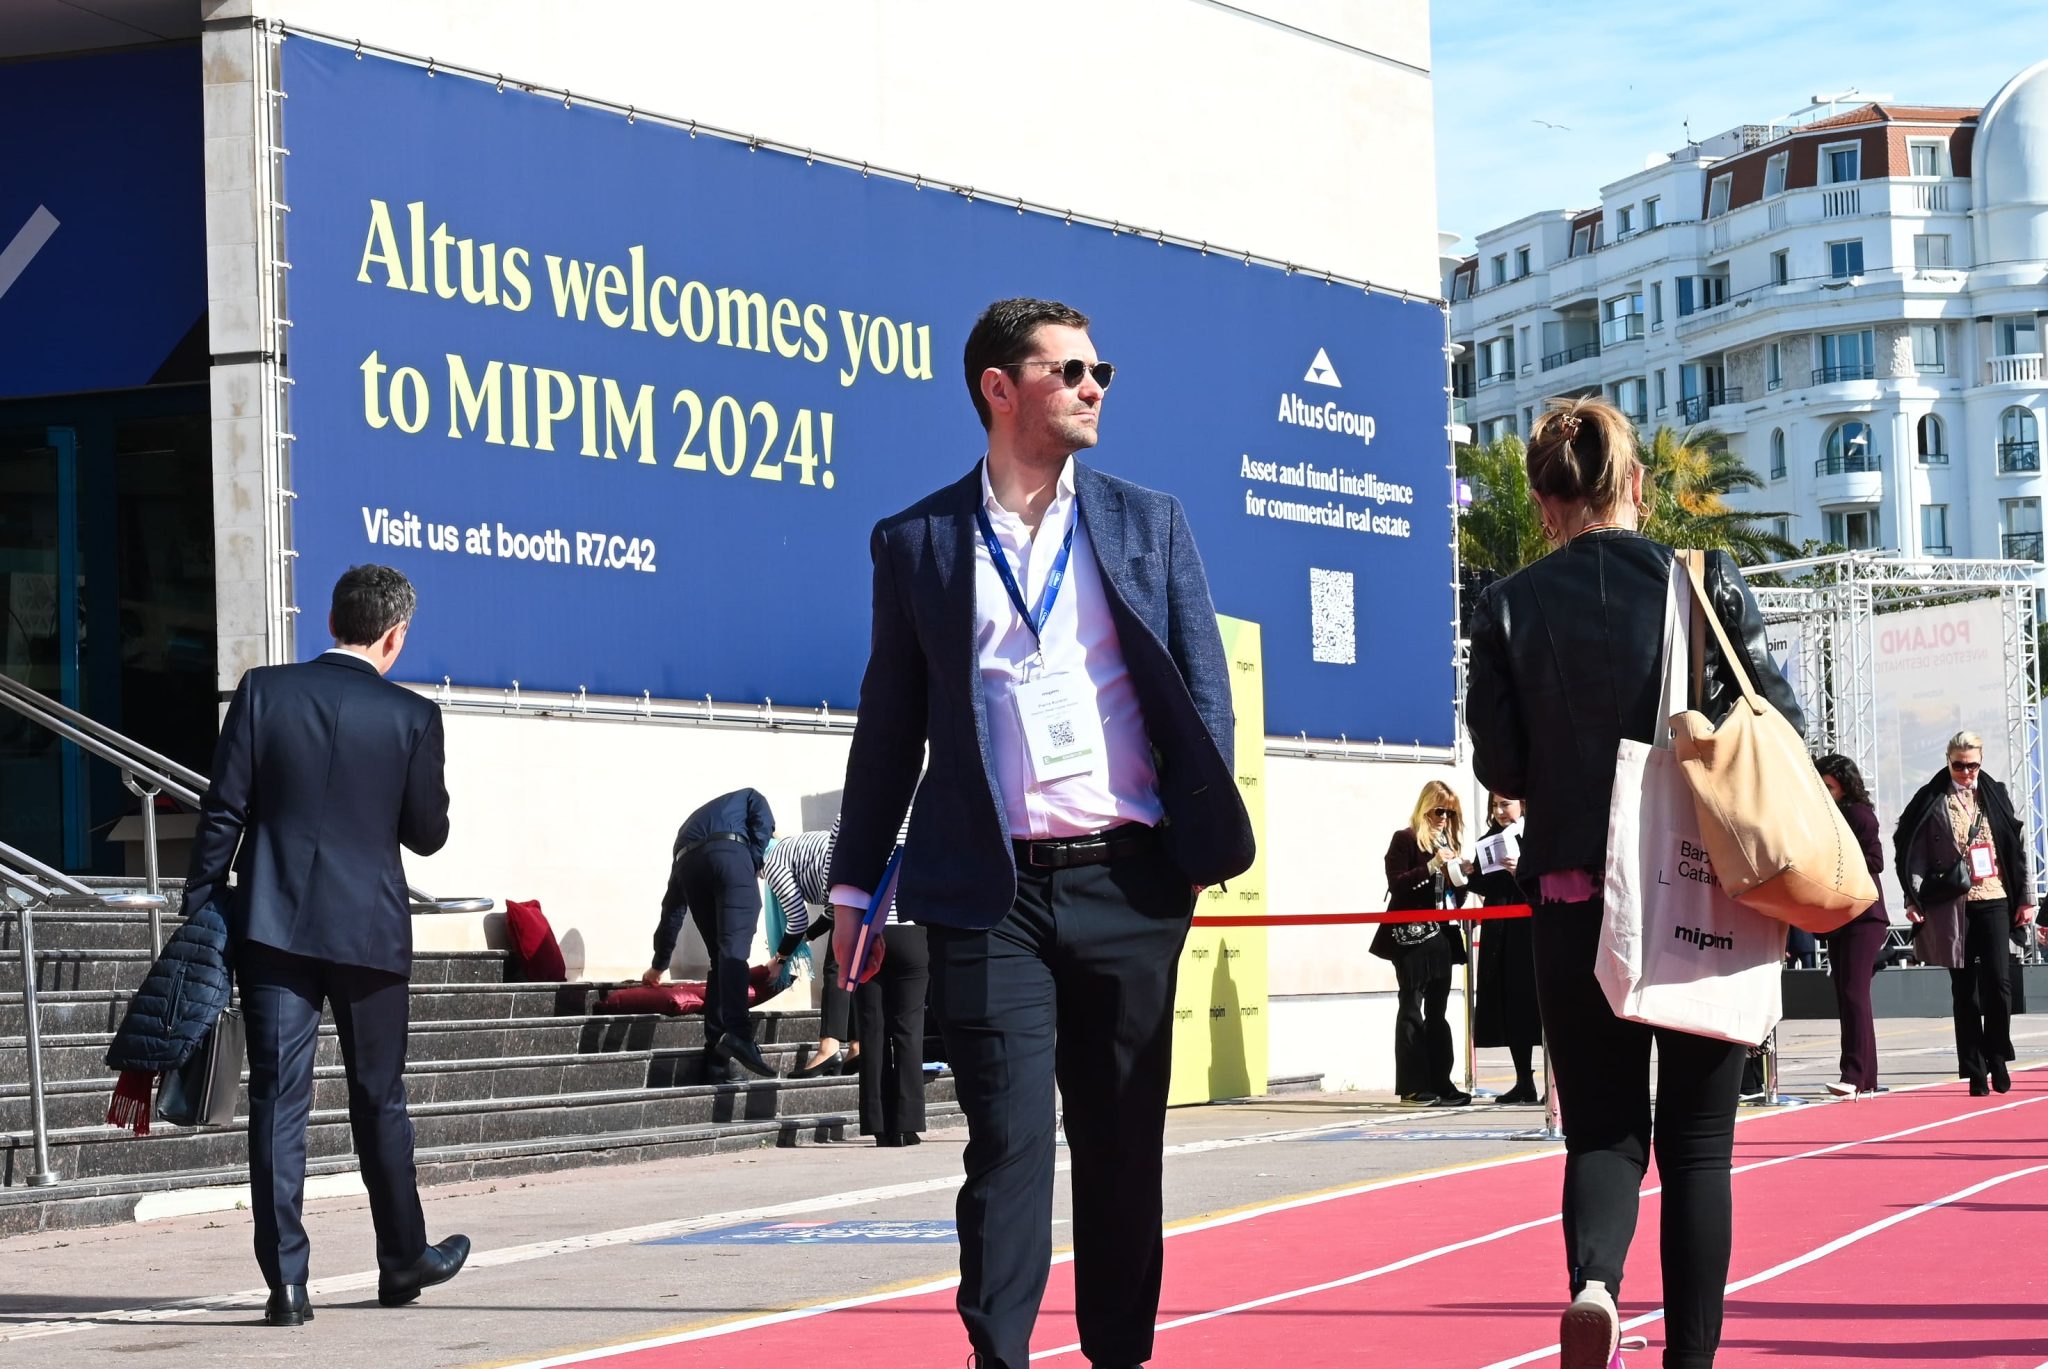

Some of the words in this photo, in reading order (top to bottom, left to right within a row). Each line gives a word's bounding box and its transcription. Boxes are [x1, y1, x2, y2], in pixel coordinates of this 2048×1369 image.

[357, 199, 531, 312] Altus
[545, 245, 829, 363] welcomes
[838, 309, 933, 388] you
[360, 350, 430, 434] to
[446, 353, 657, 465] MIPIM
[673, 388, 836, 490] 2024!
[1241, 454, 1278, 483] Asset
[1279, 462, 1305, 487] and
[1307, 463, 1338, 492] fund
[1339, 468, 1413, 505] intelligence
[1246, 489, 1267, 516] for
[1267, 501, 1344, 529] commercial
[1346, 507, 1371, 532] real
[1372, 515, 1411, 538] estate
[362, 507, 422, 548] Visit
[428, 523, 459, 552] us
[465, 522, 491, 556] at
[497, 522, 570, 564] booth
[576, 531, 656, 573] R7.C42
[1767, 638, 1787, 652] pim
[1236, 660, 1255, 673] mipim
[1238, 775, 1258, 789] mipim
[1239, 889, 1260, 904] mipim
[1675, 925, 1733, 951] mipim
[1192, 948, 1209, 961] mipim
[1223, 948, 1240, 961] mipim
[1175, 1008, 1193, 1022] mipim
[1209, 1007, 1226, 1022] mipim
[1240, 1007, 1259, 1020] mipim
